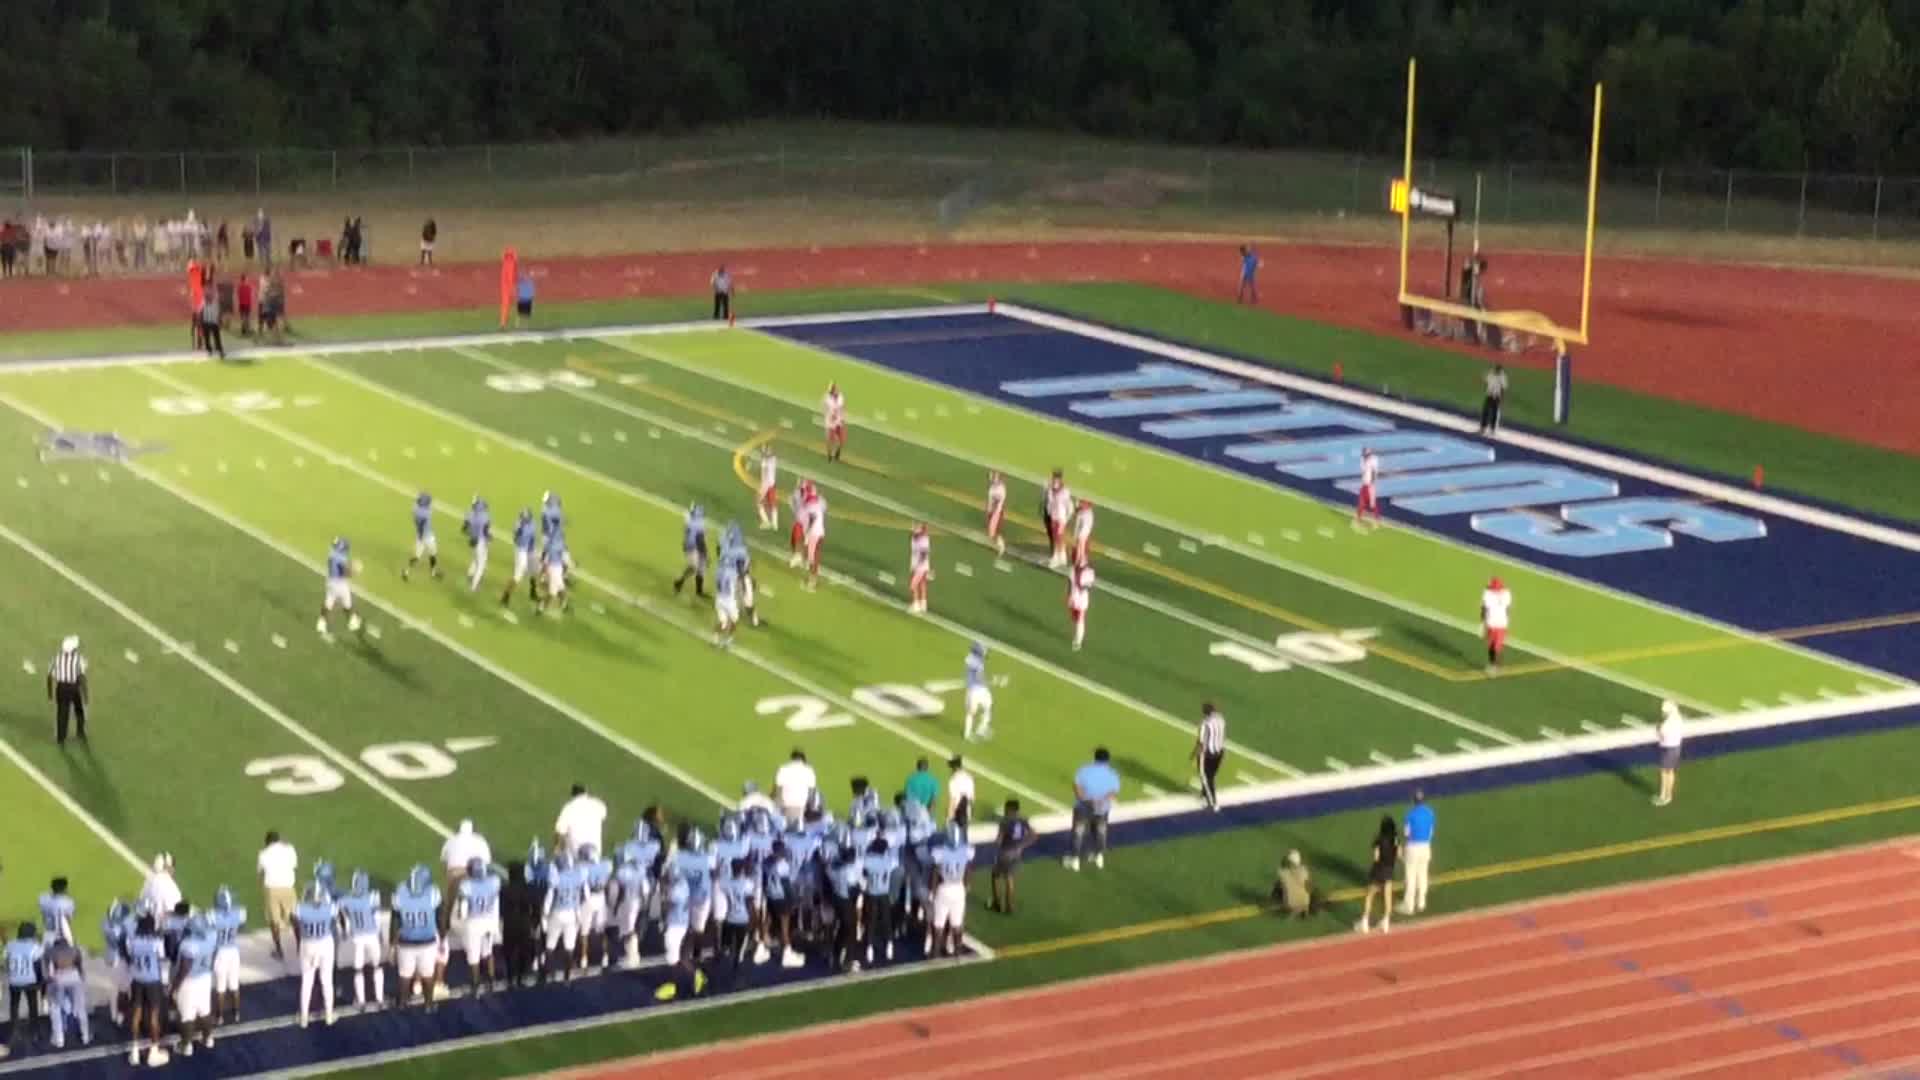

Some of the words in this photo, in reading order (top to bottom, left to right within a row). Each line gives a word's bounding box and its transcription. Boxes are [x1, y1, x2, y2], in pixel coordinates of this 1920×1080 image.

[1000, 362, 1768, 557] TITANS
[1209, 631, 1367, 672] 10
[755, 683, 945, 731] 20
[244, 741, 457, 795] 30
